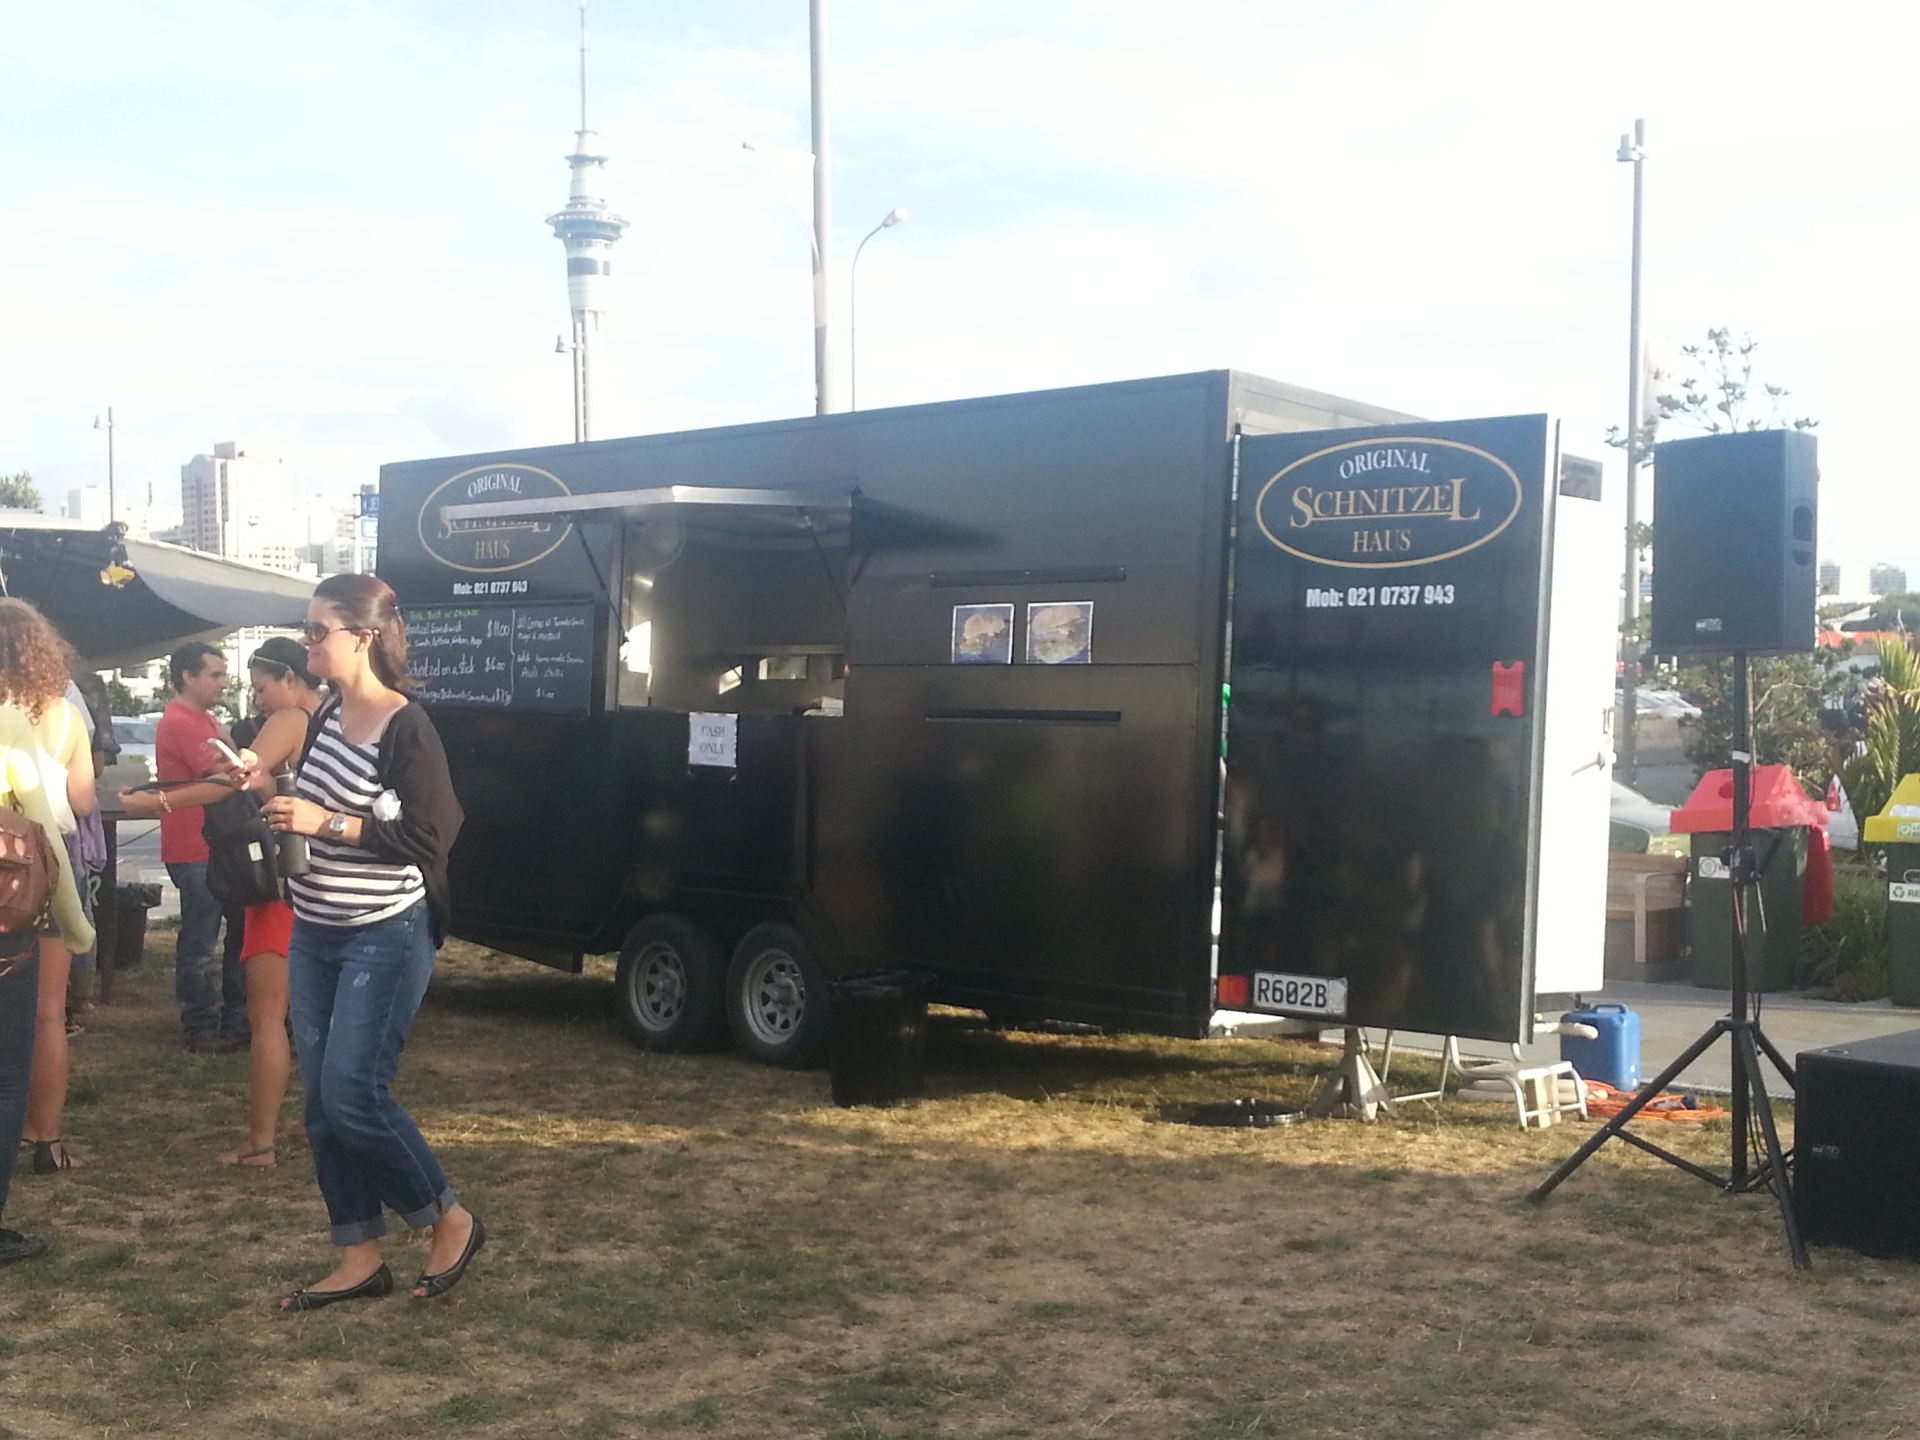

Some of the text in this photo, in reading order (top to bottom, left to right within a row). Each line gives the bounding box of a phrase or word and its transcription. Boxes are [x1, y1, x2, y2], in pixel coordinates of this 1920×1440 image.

[1339, 448, 1431, 479] ORIGINAL
[468, 473, 522, 498] ORIGINAL
[1290, 478, 1481, 528] SCHNITZEL
[475, 540, 511, 560] HAUS
[1352, 528, 1412, 554] HAUS
[453, 580, 528, 595] Mob: 021 0737 943
[1306, 584, 1455, 608] Mob: 021 0737 943
[701, 725, 726, 738] CASH
[700, 742, 727, 755] ONLY
[1257, 977, 1327, 1008] R602B
